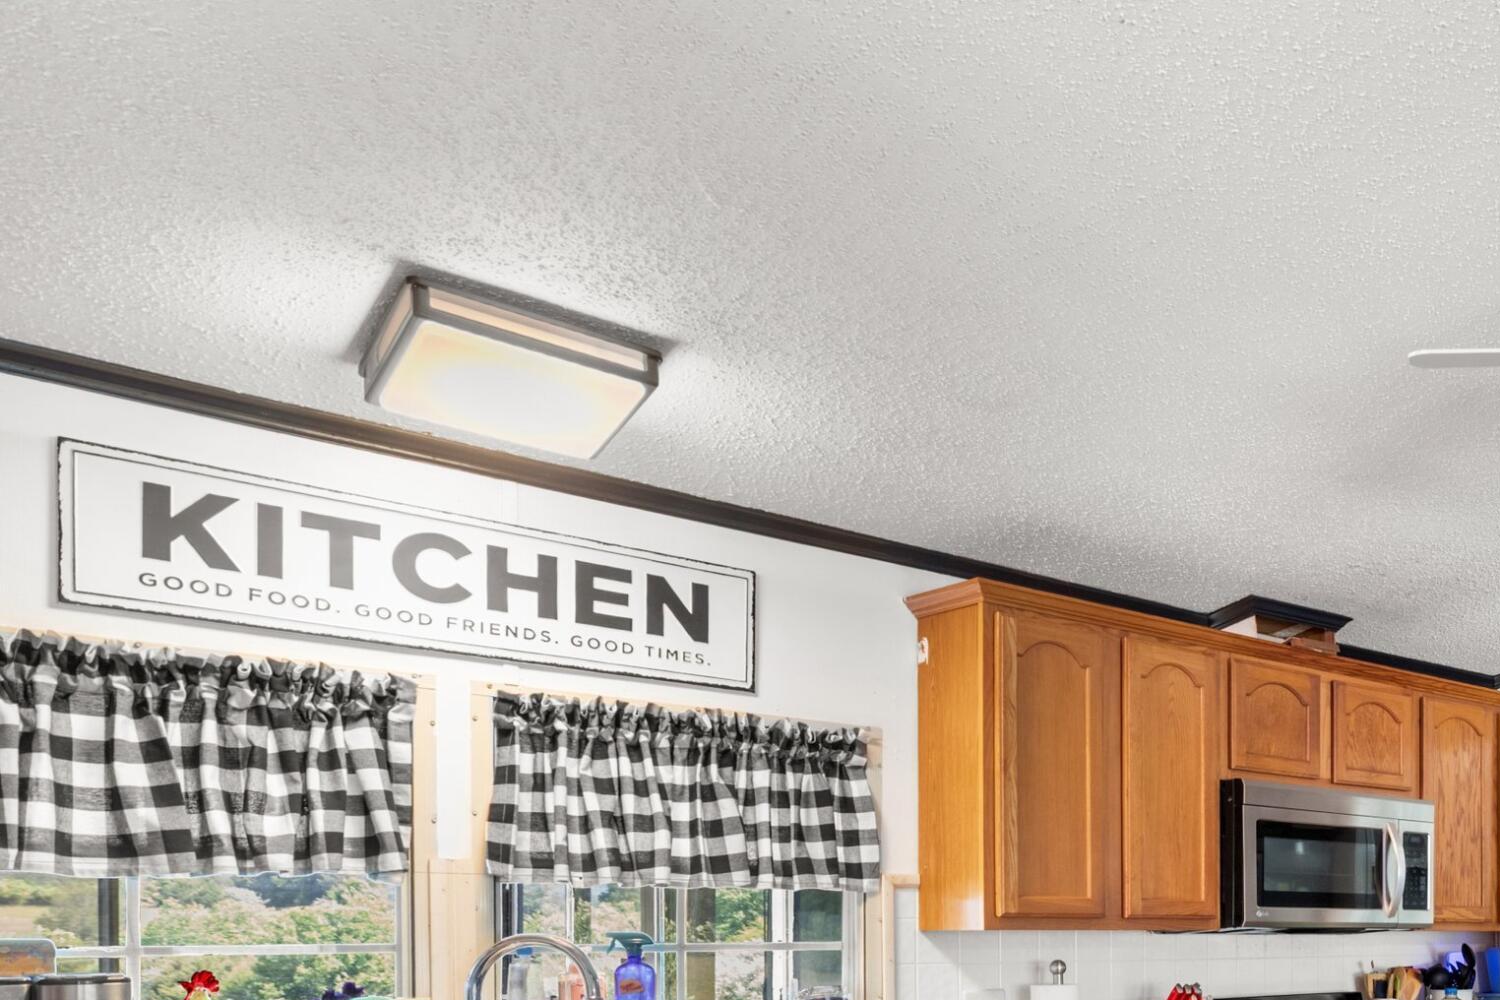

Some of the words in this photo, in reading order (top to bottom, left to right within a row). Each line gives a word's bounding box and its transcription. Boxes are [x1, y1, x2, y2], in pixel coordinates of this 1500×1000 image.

[139, 572, 232, 597] GOOD
[249, 588, 341, 613] FOOD.
[354, 604, 433, 626] GOOD
[446, 617, 559, 645] FRIENDS.
[570, 635, 634, 655] GOOD
[645, 646, 712, 666] TIMES.
[141, 481, 710, 645] KITCHEN
